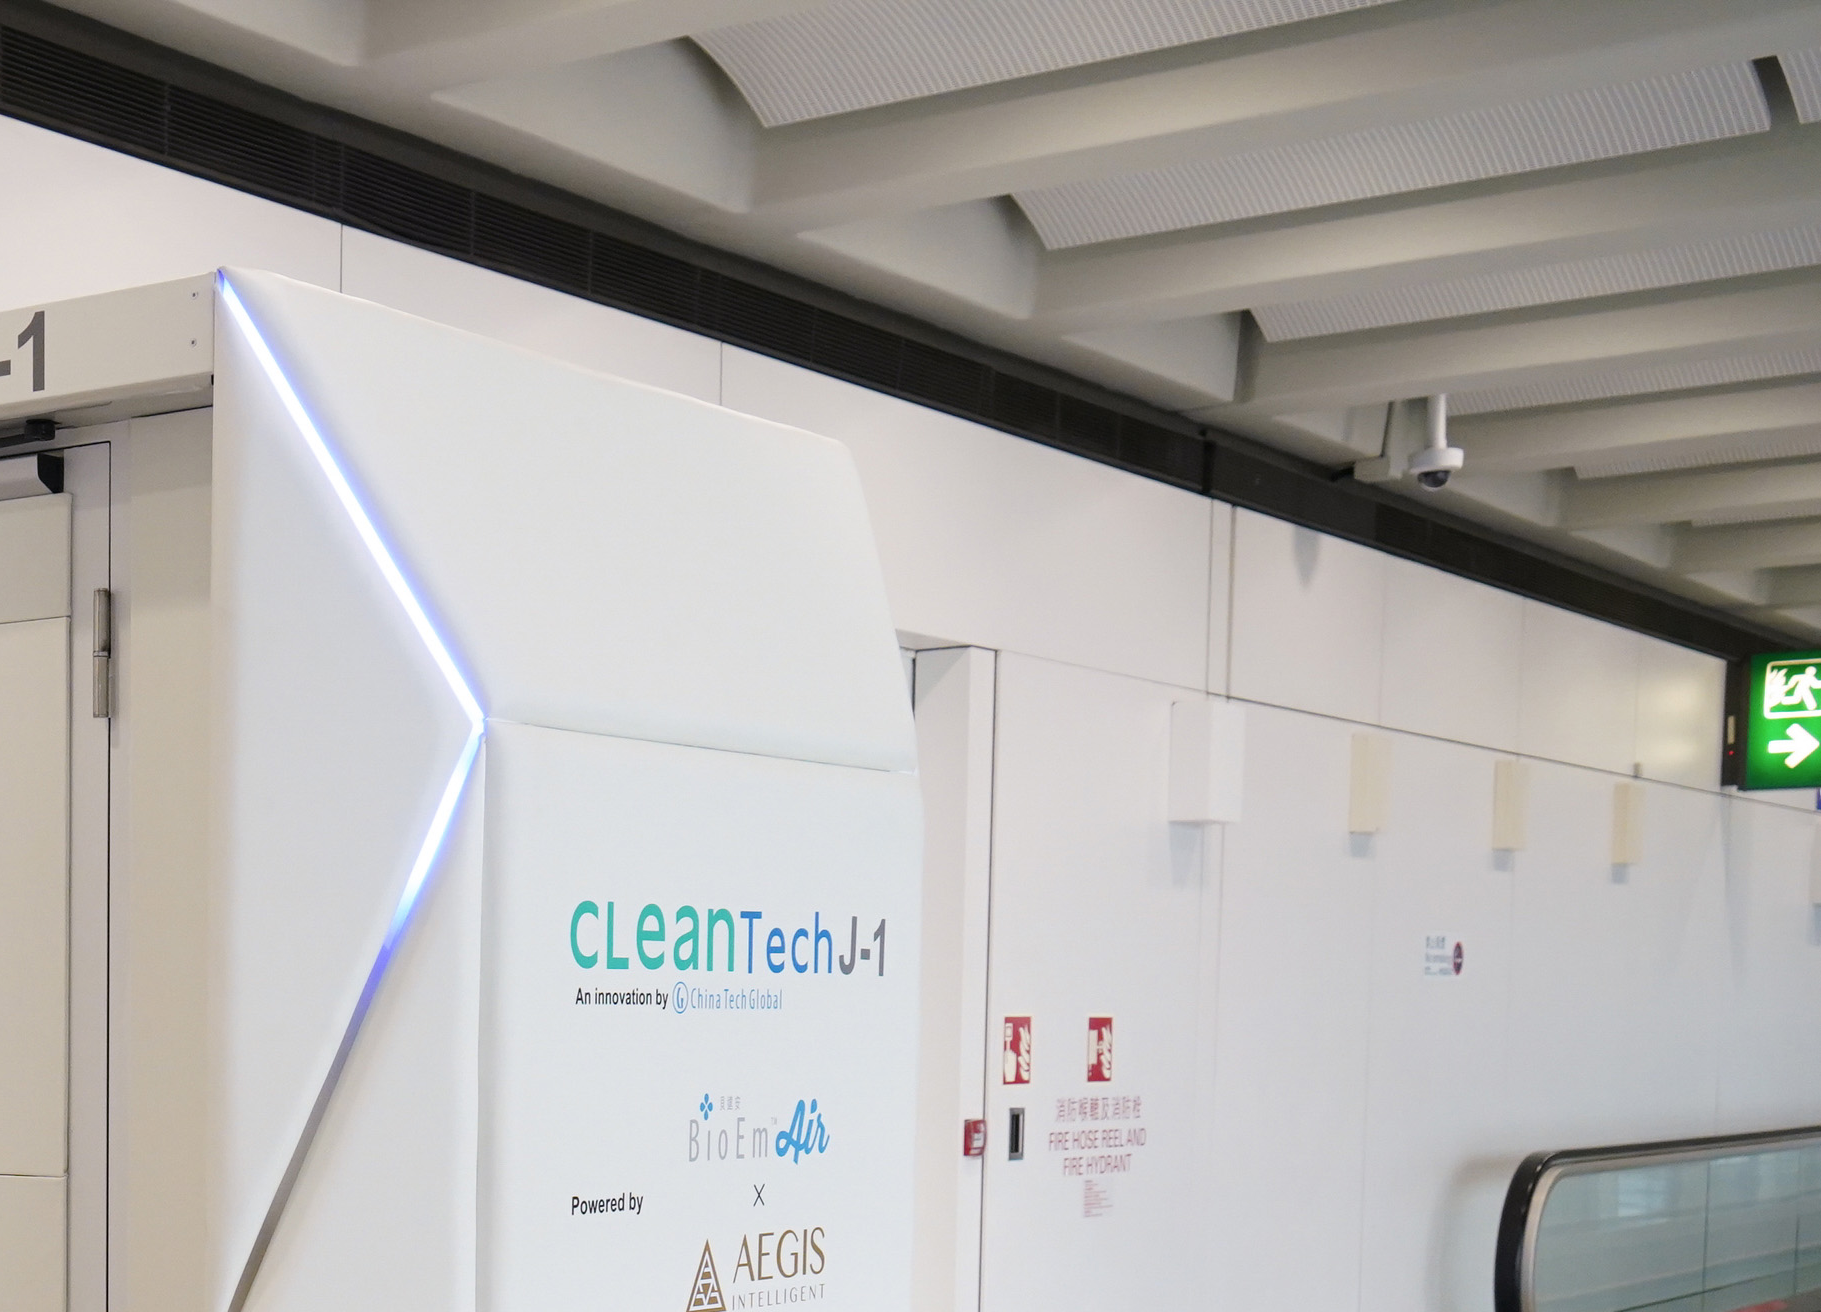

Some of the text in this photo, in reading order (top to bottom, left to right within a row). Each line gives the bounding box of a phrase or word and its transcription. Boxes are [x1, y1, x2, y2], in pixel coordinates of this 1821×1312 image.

[838, 915, 886, 977] J-1
[575, 987, 669, 1010] An innovation by
[690, 988, 783, 1010] China Tech Global
[775, 1098, 830, 1165] Air
[1048, 1127, 1147, 1151] FIRE HOSE REEL AND
[1063, 1153, 1132, 1176] FIRE HYDRANT
[571, 1191, 643, 1216] Powered by
[733, 1226, 826, 1283] AEGIS
[732, 1283, 826, 1311] INTELLIGENT
